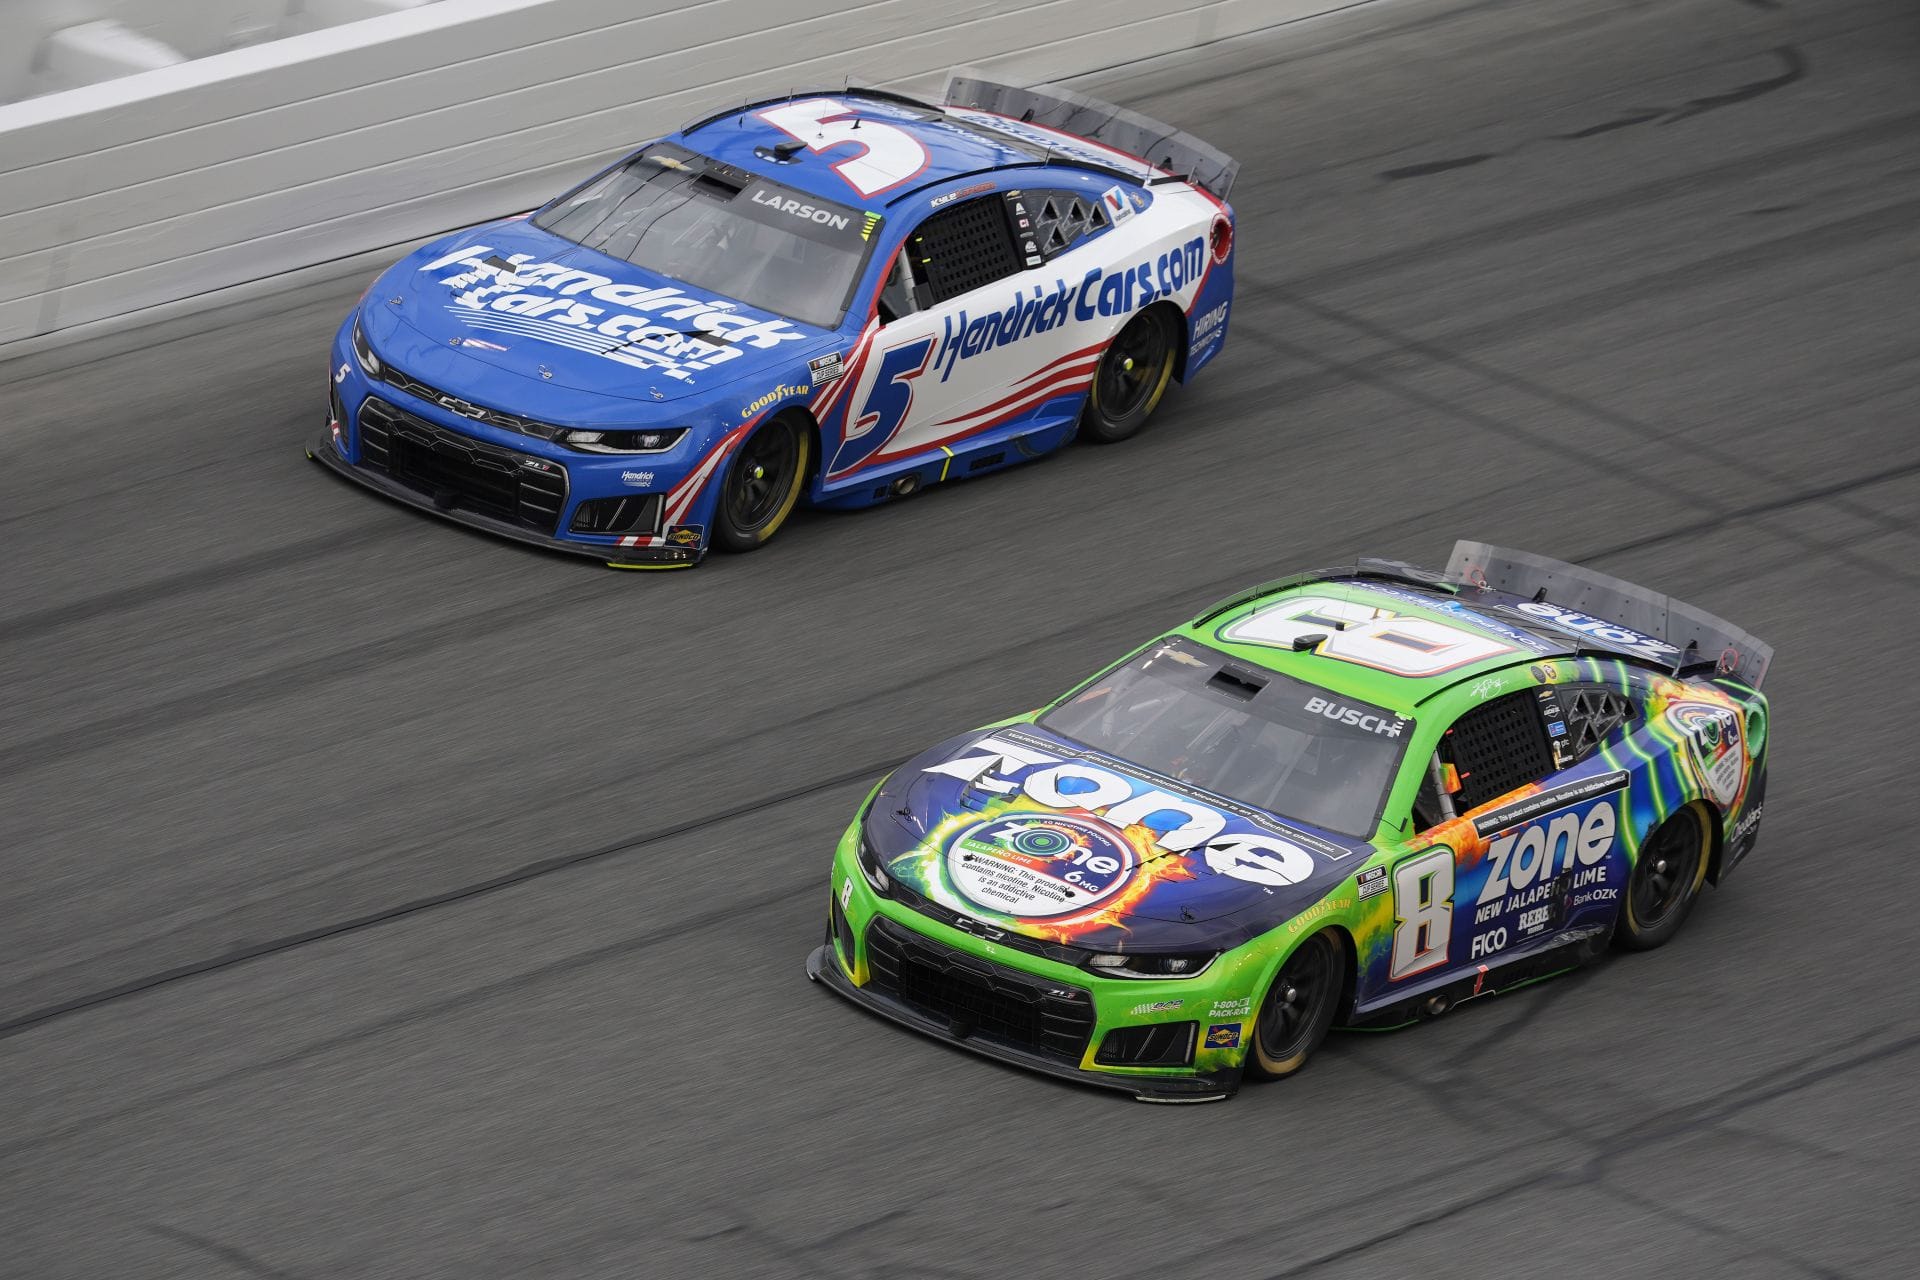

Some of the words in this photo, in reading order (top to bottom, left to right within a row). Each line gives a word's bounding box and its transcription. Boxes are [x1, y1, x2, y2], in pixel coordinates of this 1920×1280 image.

[757, 98, 931, 199] 5
[752, 190, 849, 230] LARSON
[418, 245, 806, 348] Hendrick
[933, 236, 1205, 383] HendrickCars.com
[335, 363, 351, 383] 5
[742, 384, 809, 418] GOODYEAR
[826, 332, 938, 481] 5
[621, 470, 654, 481] Hendrick
[667, 532, 701, 541] SUNOCO
[1517, 603, 1681, 658] zone
[1303, 696, 1399, 738] BUSCH
[1008, 732, 1055, 750] WARNING:
[1057, 746, 1076, 756] This
[1114, 764, 1152, 779] contains
[1191, 790, 1229, 807] Nicotine
[1292, 832, 1335, 853] chemical.
[921, 738, 1314, 888] zone
[976, 855, 1018, 874] WARNING:
[1019, 869, 1035, 881] This
[1011, 854, 1033, 865] LIME
[1476, 801, 1616, 906] zone
[841, 877, 854, 911] 8
[961, 862, 996, 877] contains
[995, 871, 1029, 888] nicotine.
[1031, 884, 1065, 903] Nicotine
[981, 886, 1020, 904] chemical
[986, 879, 998, 887] an
[998, 882, 1036, 901] addictive
[1064, 870, 1084, 883] 6
[1080, 880, 1100, 892] MG
[1474, 901, 1504, 925] NEW
[1573, 866, 1607, 889] LIME
[1573, 892, 1594, 906] Bank
[1592, 889, 1618, 901] OZK
[1389, 843, 1455, 982] 8
[1471, 927, 1508, 960] FICO
[1209, 1007, 1251, 1017] PACK-RAT
[1208, 1031, 1240, 1041] SUNOCO
